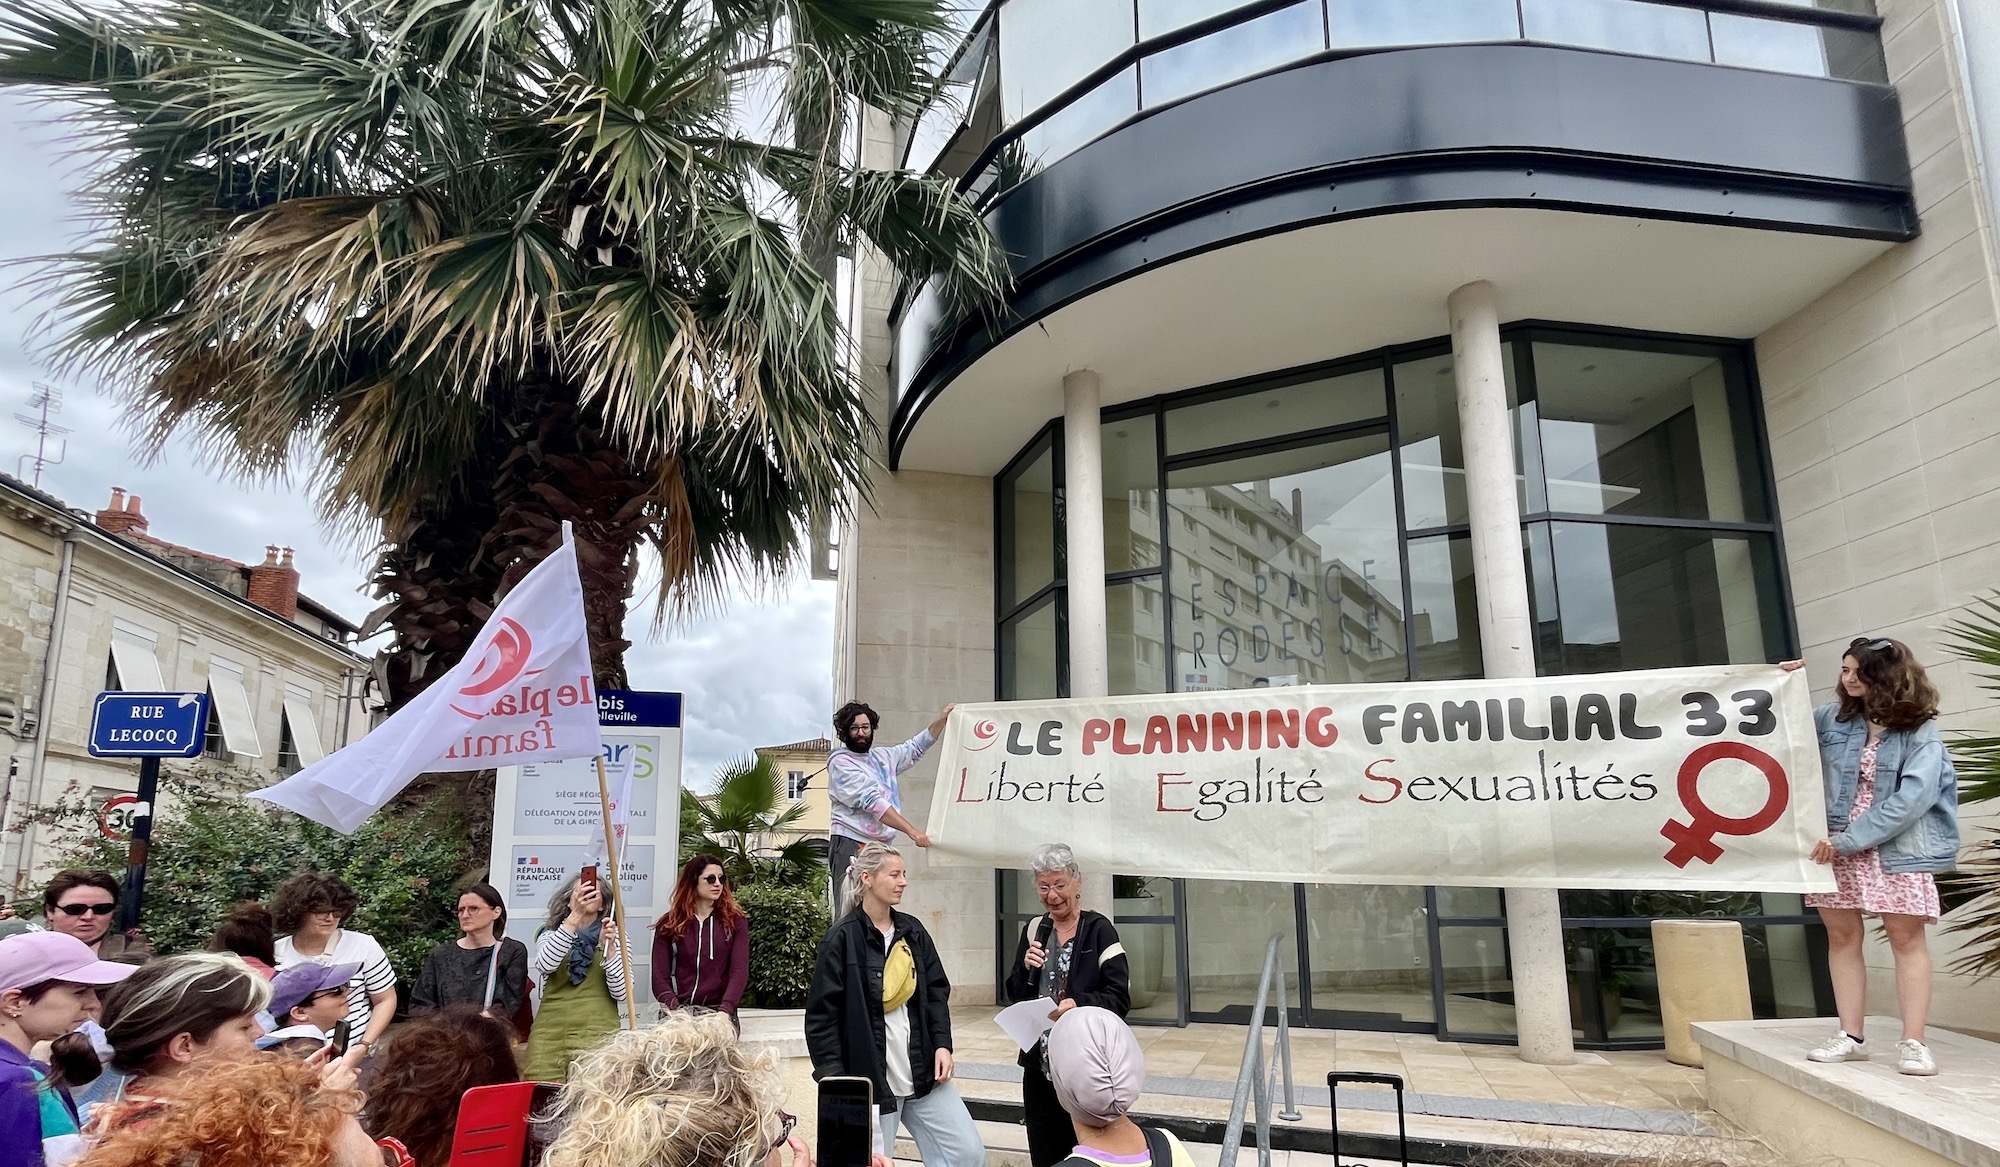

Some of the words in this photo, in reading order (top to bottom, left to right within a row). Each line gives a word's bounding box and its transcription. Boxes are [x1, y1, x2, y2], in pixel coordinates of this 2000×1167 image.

[1191, 559, 1377, 621] ESPACE
[1192, 609, 1380, 669] RODESSE
[599, 695, 624, 710] bis
[131, 706, 164, 718] RUE
[1006, 719, 1063, 756] LE
[1081, 706, 1339, 755] PLANNING
[1362, 692, 1662, 745] FAMILIAL
[1680, 689, 1777, 737] 33
[109, 729, 178, 744] LECOCQ
[955, 761, 1105, 804] Liberté
[1156, 756, 1324, 821] Egalité
[1358, 749, 1658, 804] Sexualités
[524, 809, 576, 817] DÉLÉGATION
[516, 866, 565, 874] RÉPUBLIQUE
